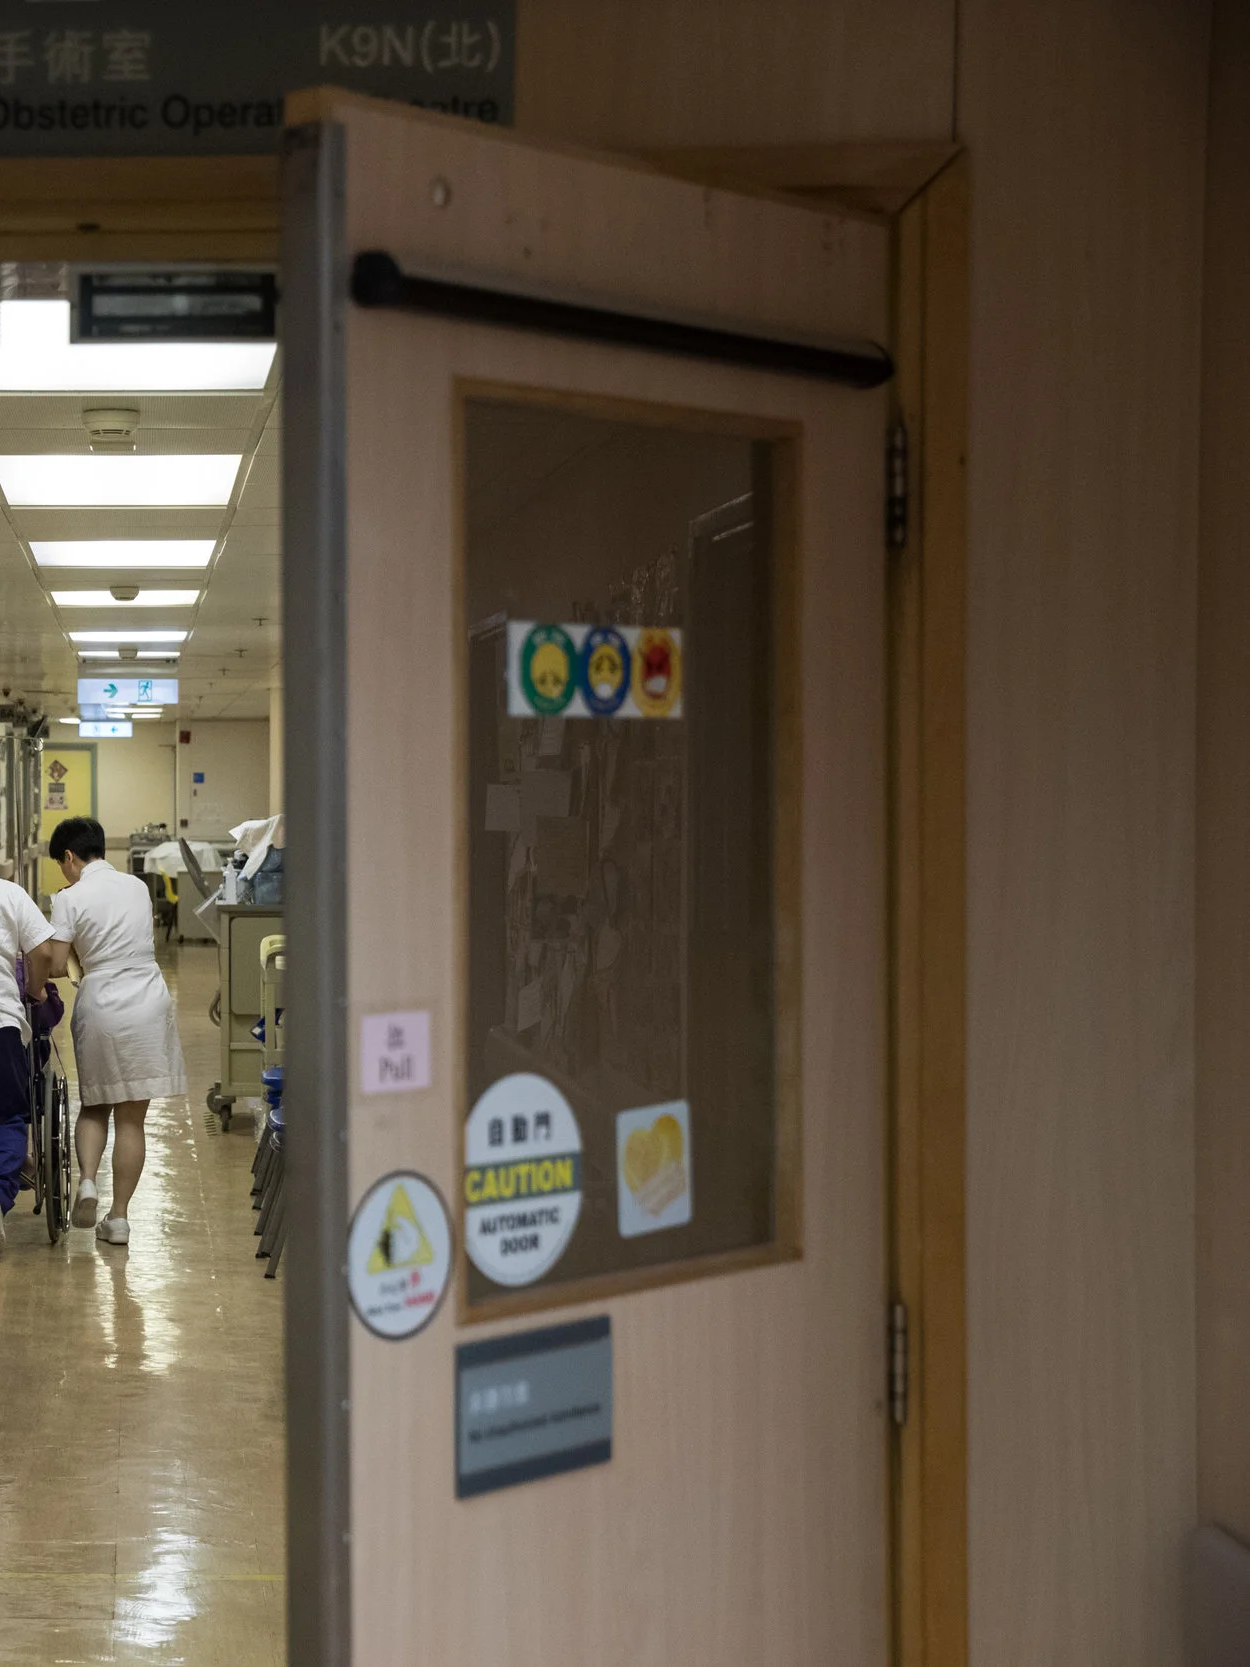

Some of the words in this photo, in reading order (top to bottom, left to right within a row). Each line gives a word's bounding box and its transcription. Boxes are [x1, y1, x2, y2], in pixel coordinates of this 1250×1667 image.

[319, 20, 501, 73] K9N(北)
[466, 1158, 574, 1202] CAUTION
[480, 1206, 561, 1236] AUTOMATIC
[500, 1233, 540, 1257] DOOR
